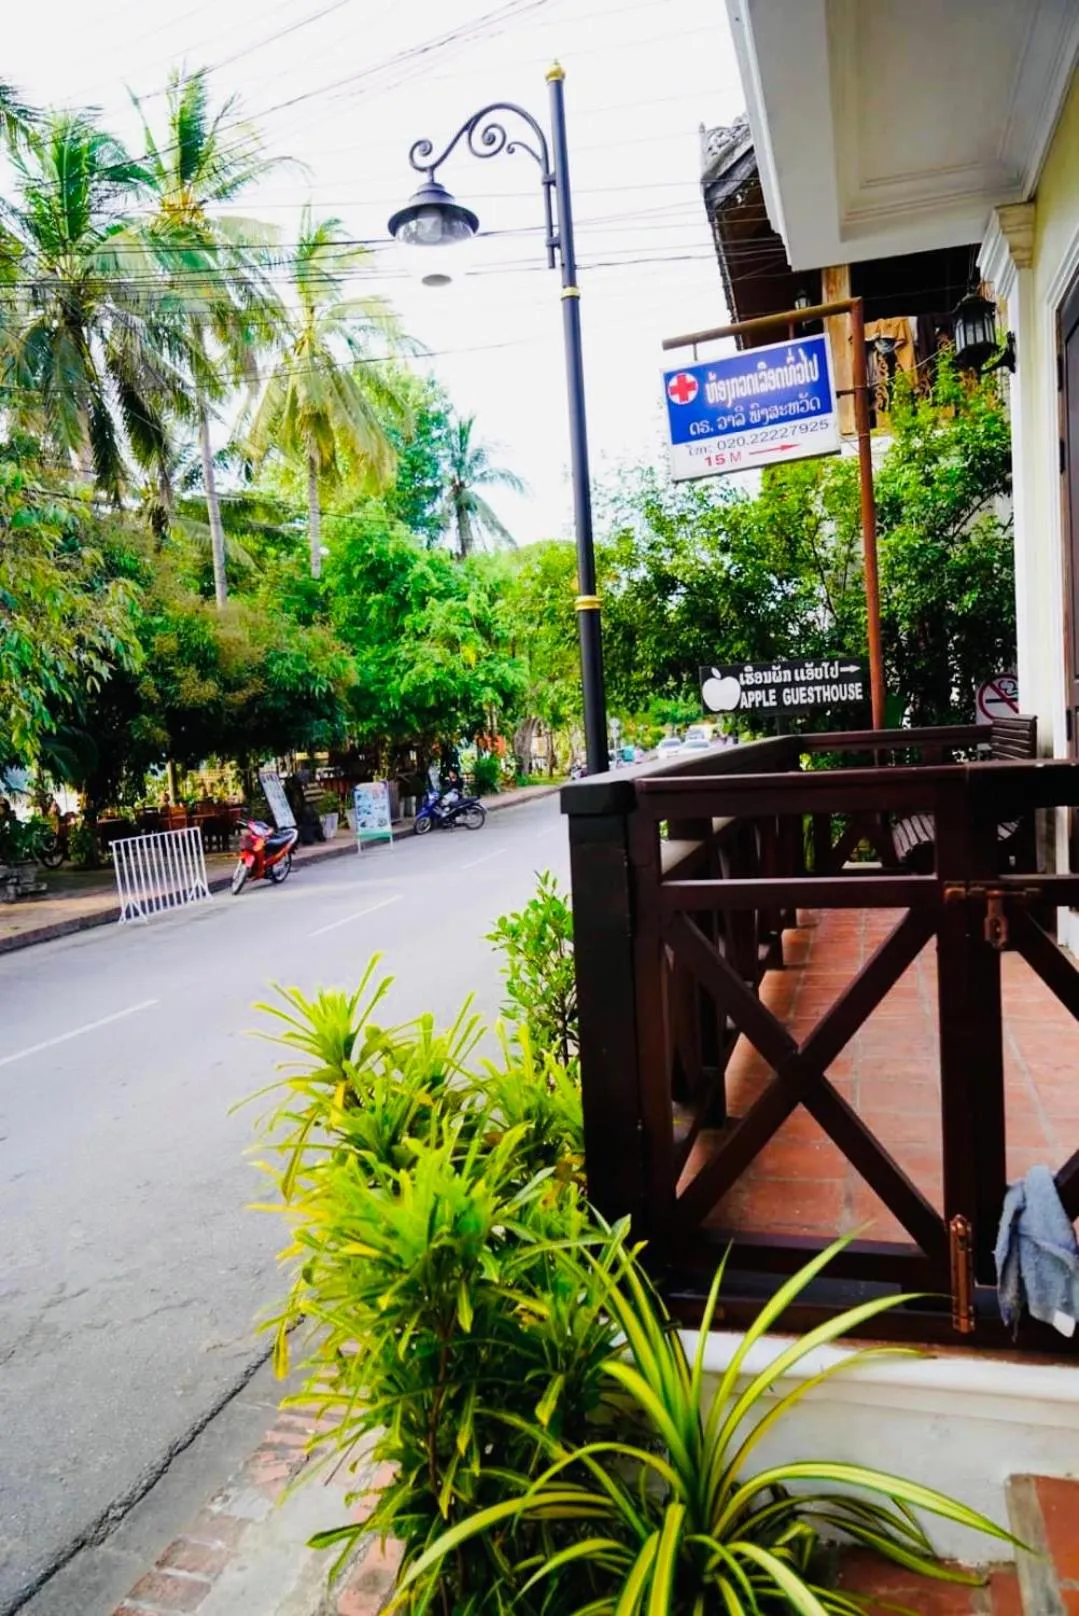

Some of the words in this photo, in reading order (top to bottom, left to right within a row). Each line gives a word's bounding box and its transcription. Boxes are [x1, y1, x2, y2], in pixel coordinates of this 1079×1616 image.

[717, 419, 829, 450] 020.22227925
[704, 453, 726, 467] 15
[730, 451, 742, 463] M
[740, 689, 778, 709] APPLE
[782, 682, 864, 706] GUESTHOUSE
